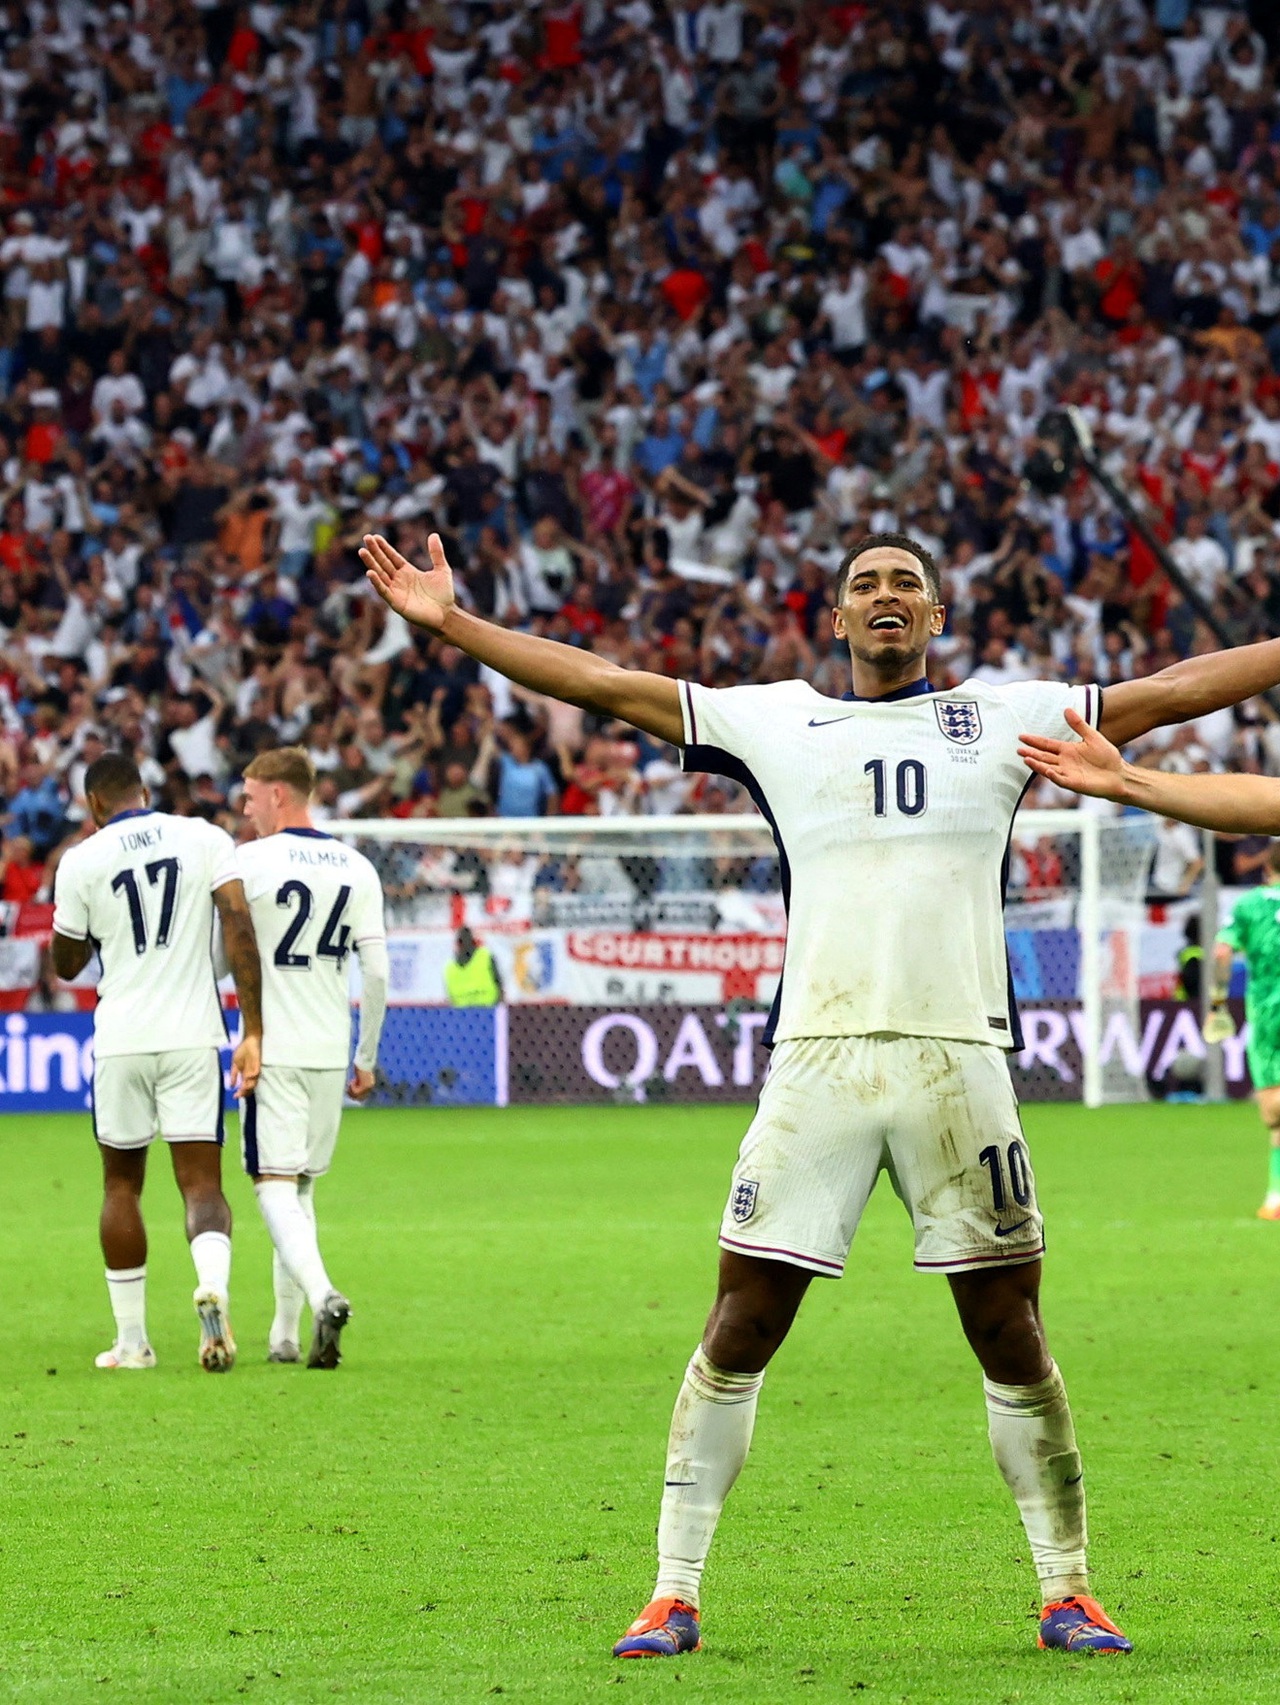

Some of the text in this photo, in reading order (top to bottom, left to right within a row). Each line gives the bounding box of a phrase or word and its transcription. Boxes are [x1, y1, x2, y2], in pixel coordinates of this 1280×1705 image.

[864, 759, 928, 818] 10
[120, 826, 164, 852] TONEY
[290, 848, 349, 868] PALMER
[111, 857, 182, 957] 17
[274, 879, 354, 972] 24
[570, 932, 784, 971] COURTHOUS
[581, 1008, 1250, 1103] QAT RWAY
[978, 1140, 1031, 1212] 10
